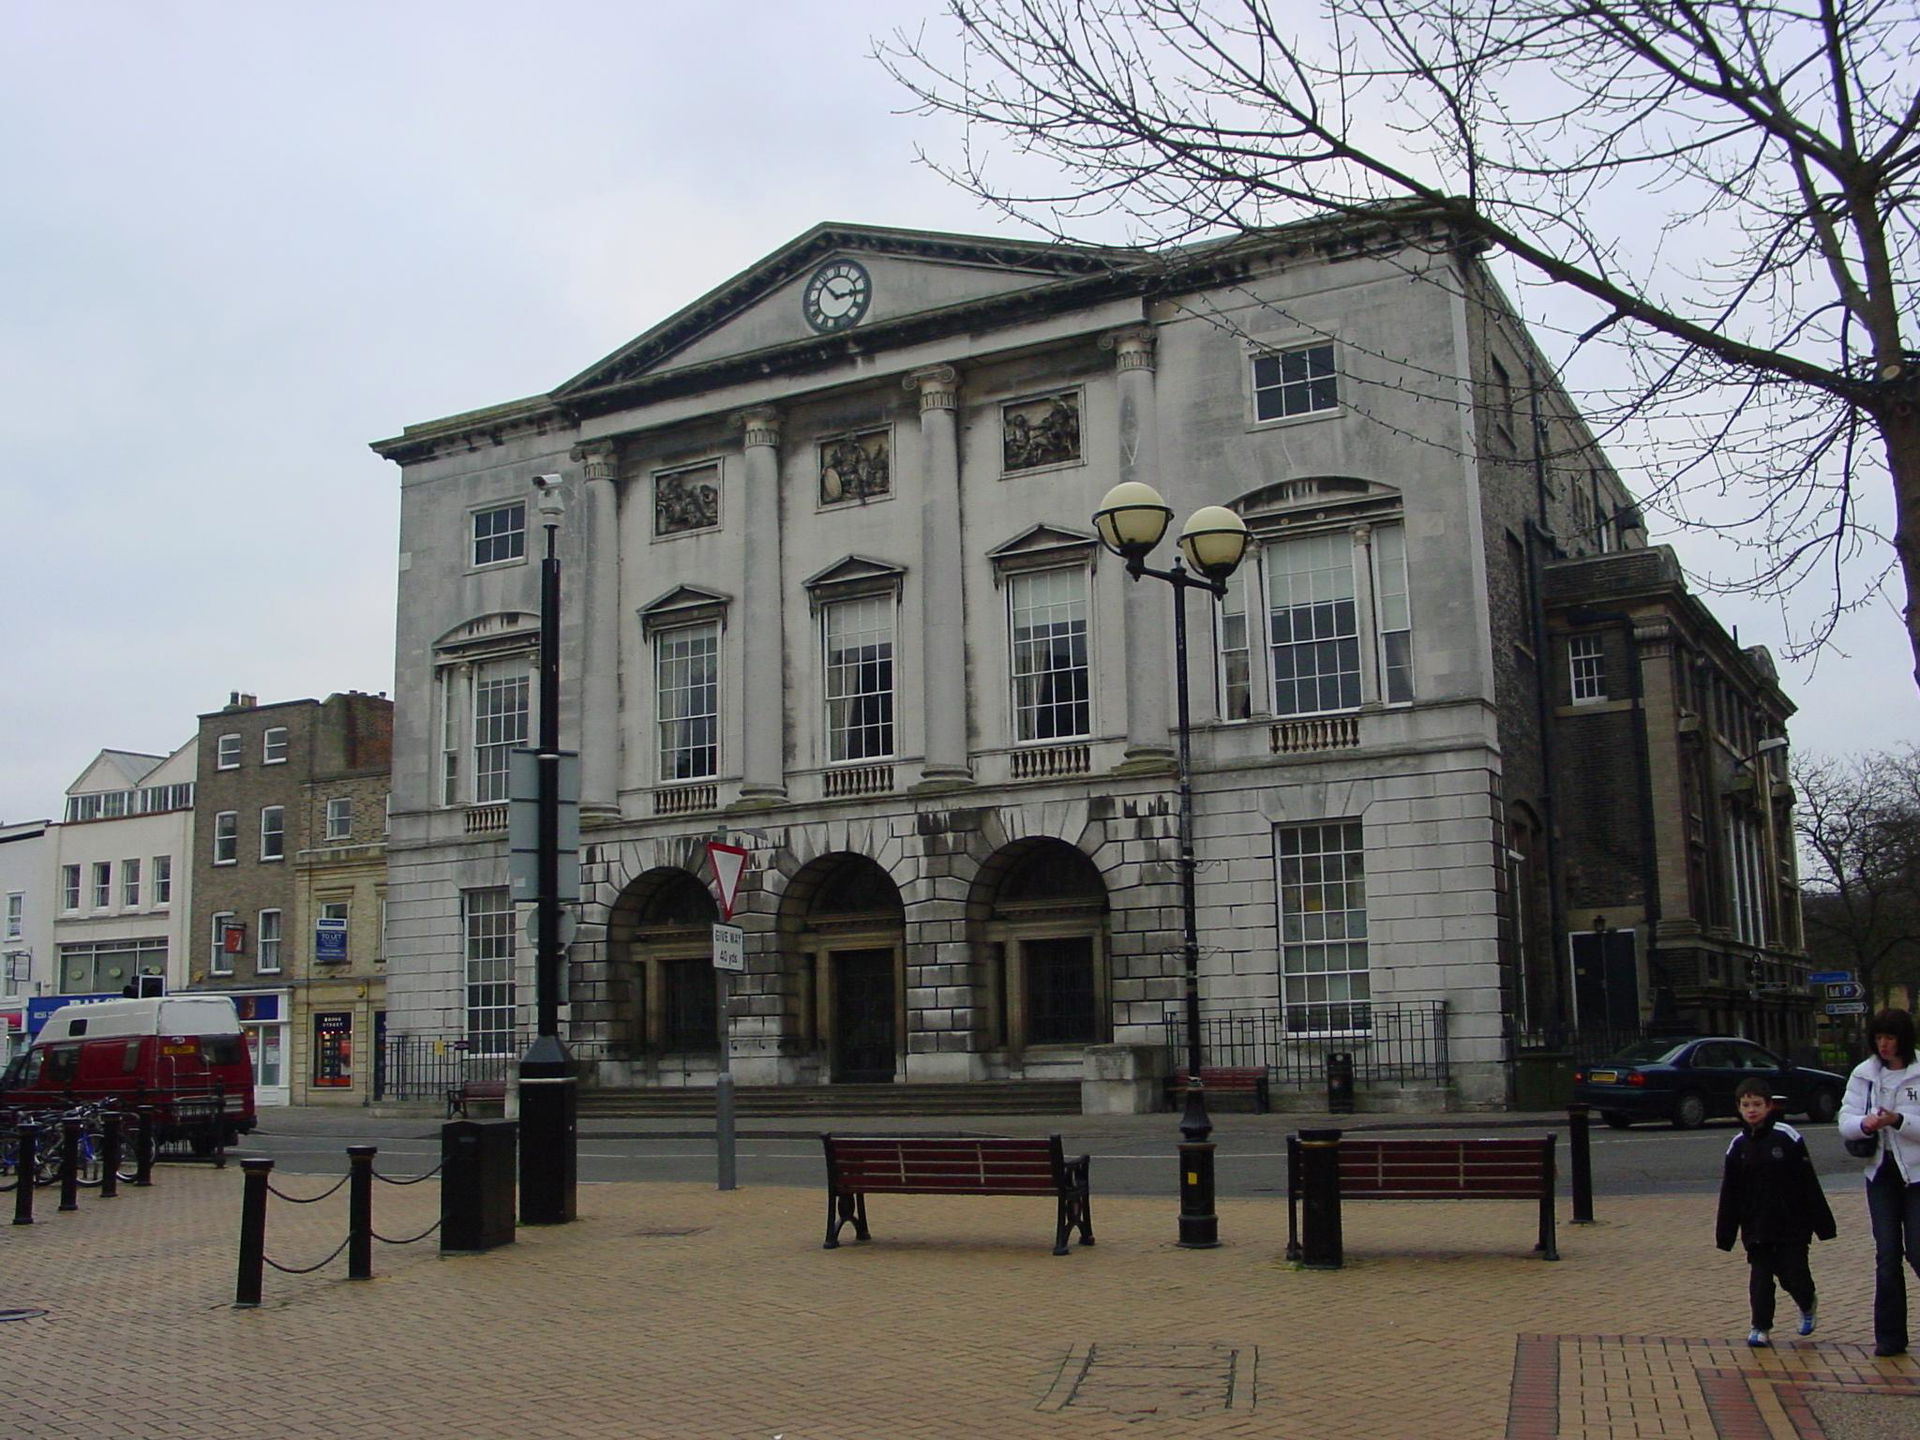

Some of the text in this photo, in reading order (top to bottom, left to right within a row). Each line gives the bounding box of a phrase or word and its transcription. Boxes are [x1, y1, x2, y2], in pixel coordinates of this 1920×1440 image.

[715, 930, 742, 945] GIVE WAY
[719, 950, 738, 966] 40 yds
[1843, 985, 1851, 995] P
